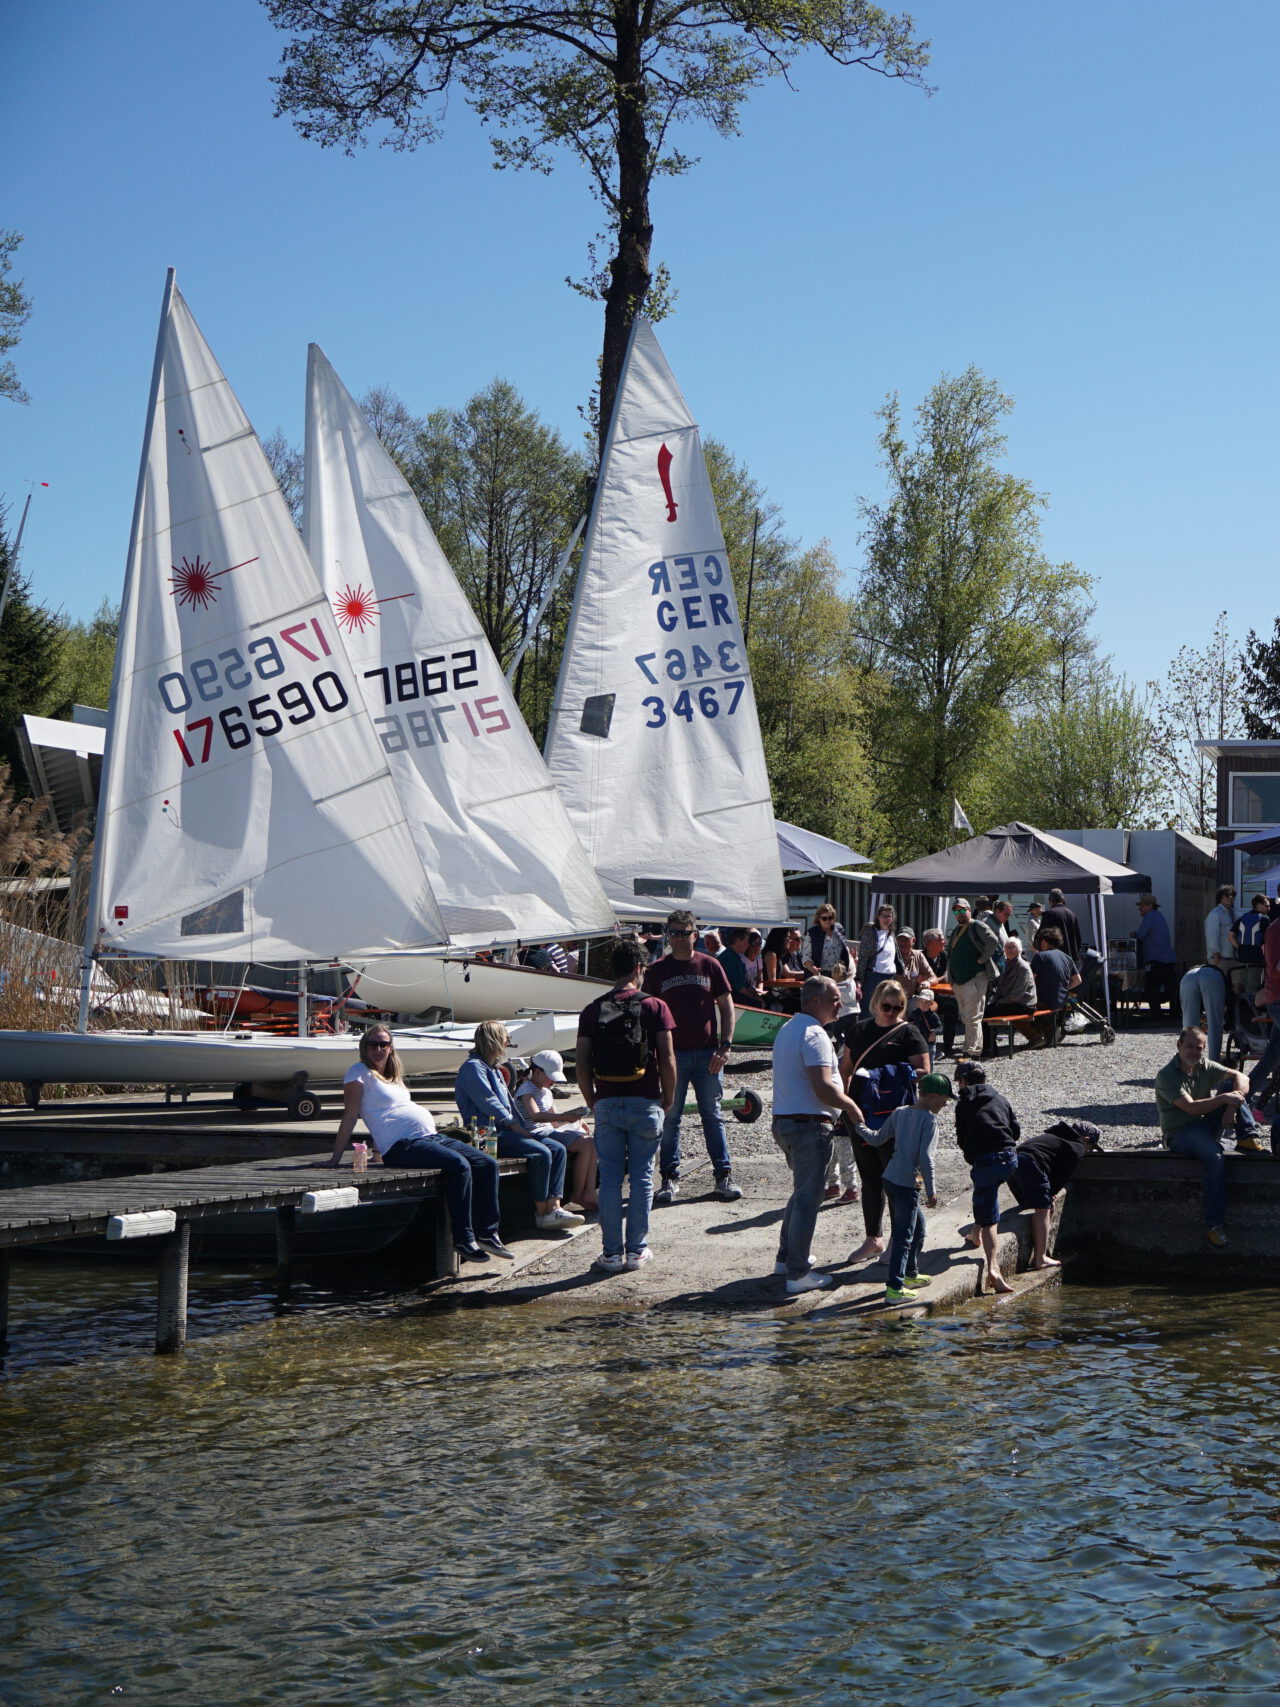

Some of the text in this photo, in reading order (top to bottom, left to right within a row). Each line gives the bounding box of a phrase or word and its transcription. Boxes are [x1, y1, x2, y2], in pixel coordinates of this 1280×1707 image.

[656, 593, 733, 632] GER
[364, 649, 479, 705] 7862
[173, 671, 349, 767] 176590
[641, 680, 745, 729] 3467
